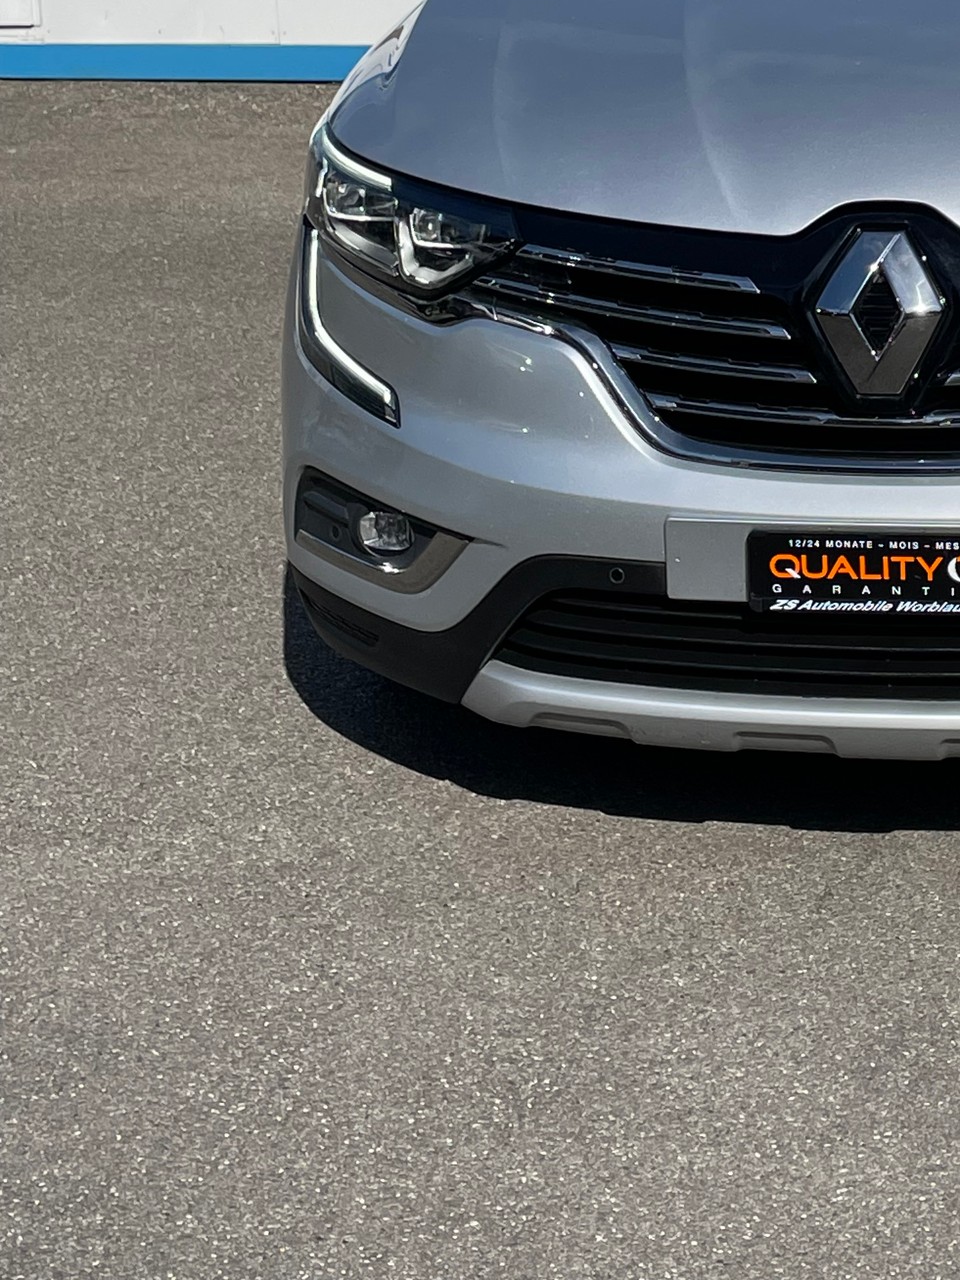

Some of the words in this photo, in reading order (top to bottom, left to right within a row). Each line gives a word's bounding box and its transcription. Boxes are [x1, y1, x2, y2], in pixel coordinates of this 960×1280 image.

[788, 539, 820, 548] 12/24
[825, 540, 873, 549] MONATE
[889, 541, 920, 550] MOIS
[769, 553, 944, 582] QUALITY
[769, 599, 800, 611] ZS
[797, 599, 894, 613] Automobile
